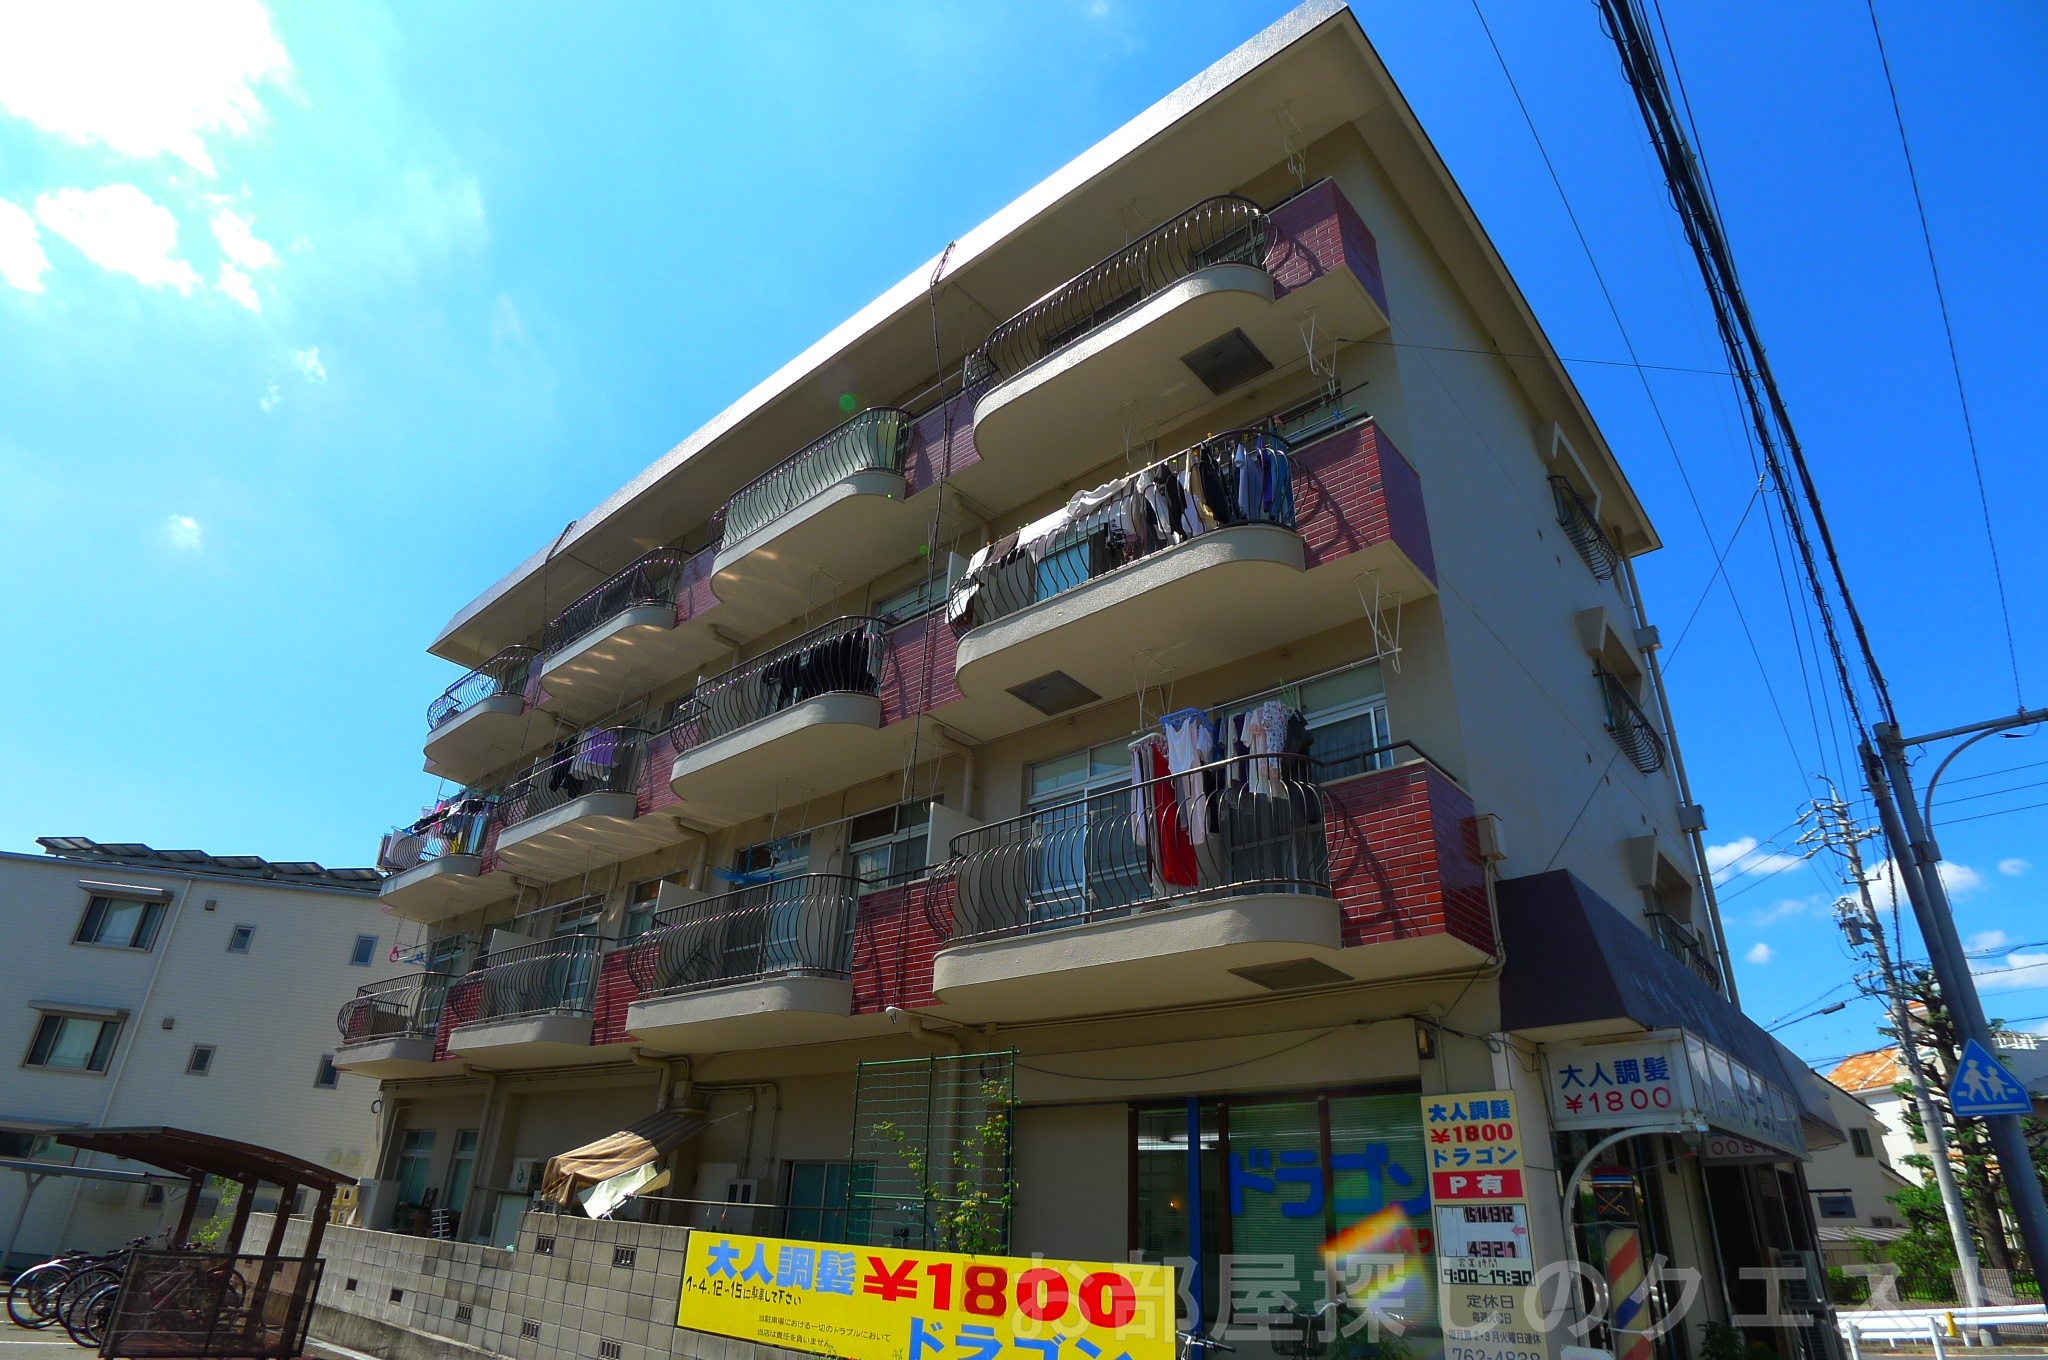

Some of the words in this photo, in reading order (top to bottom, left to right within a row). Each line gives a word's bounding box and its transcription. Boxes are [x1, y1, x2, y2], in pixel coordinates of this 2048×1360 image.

[1559, 1056, 1670, 1089] 大人調髪
[1428, 1099, 1511, 1123] 大人調髪
[1564, 1086, 1672, 1114] ¥1800
[1430, 1123, 1513, 1144] ¥1800
[1433, 1146, 1518, 1168] ドラゴン
[705, 1240, 857, 1296] 大人調髪
[863, 1256, 1137, 1328] ¥1800
[1466, 1293, 1514, 1309] 定休日
